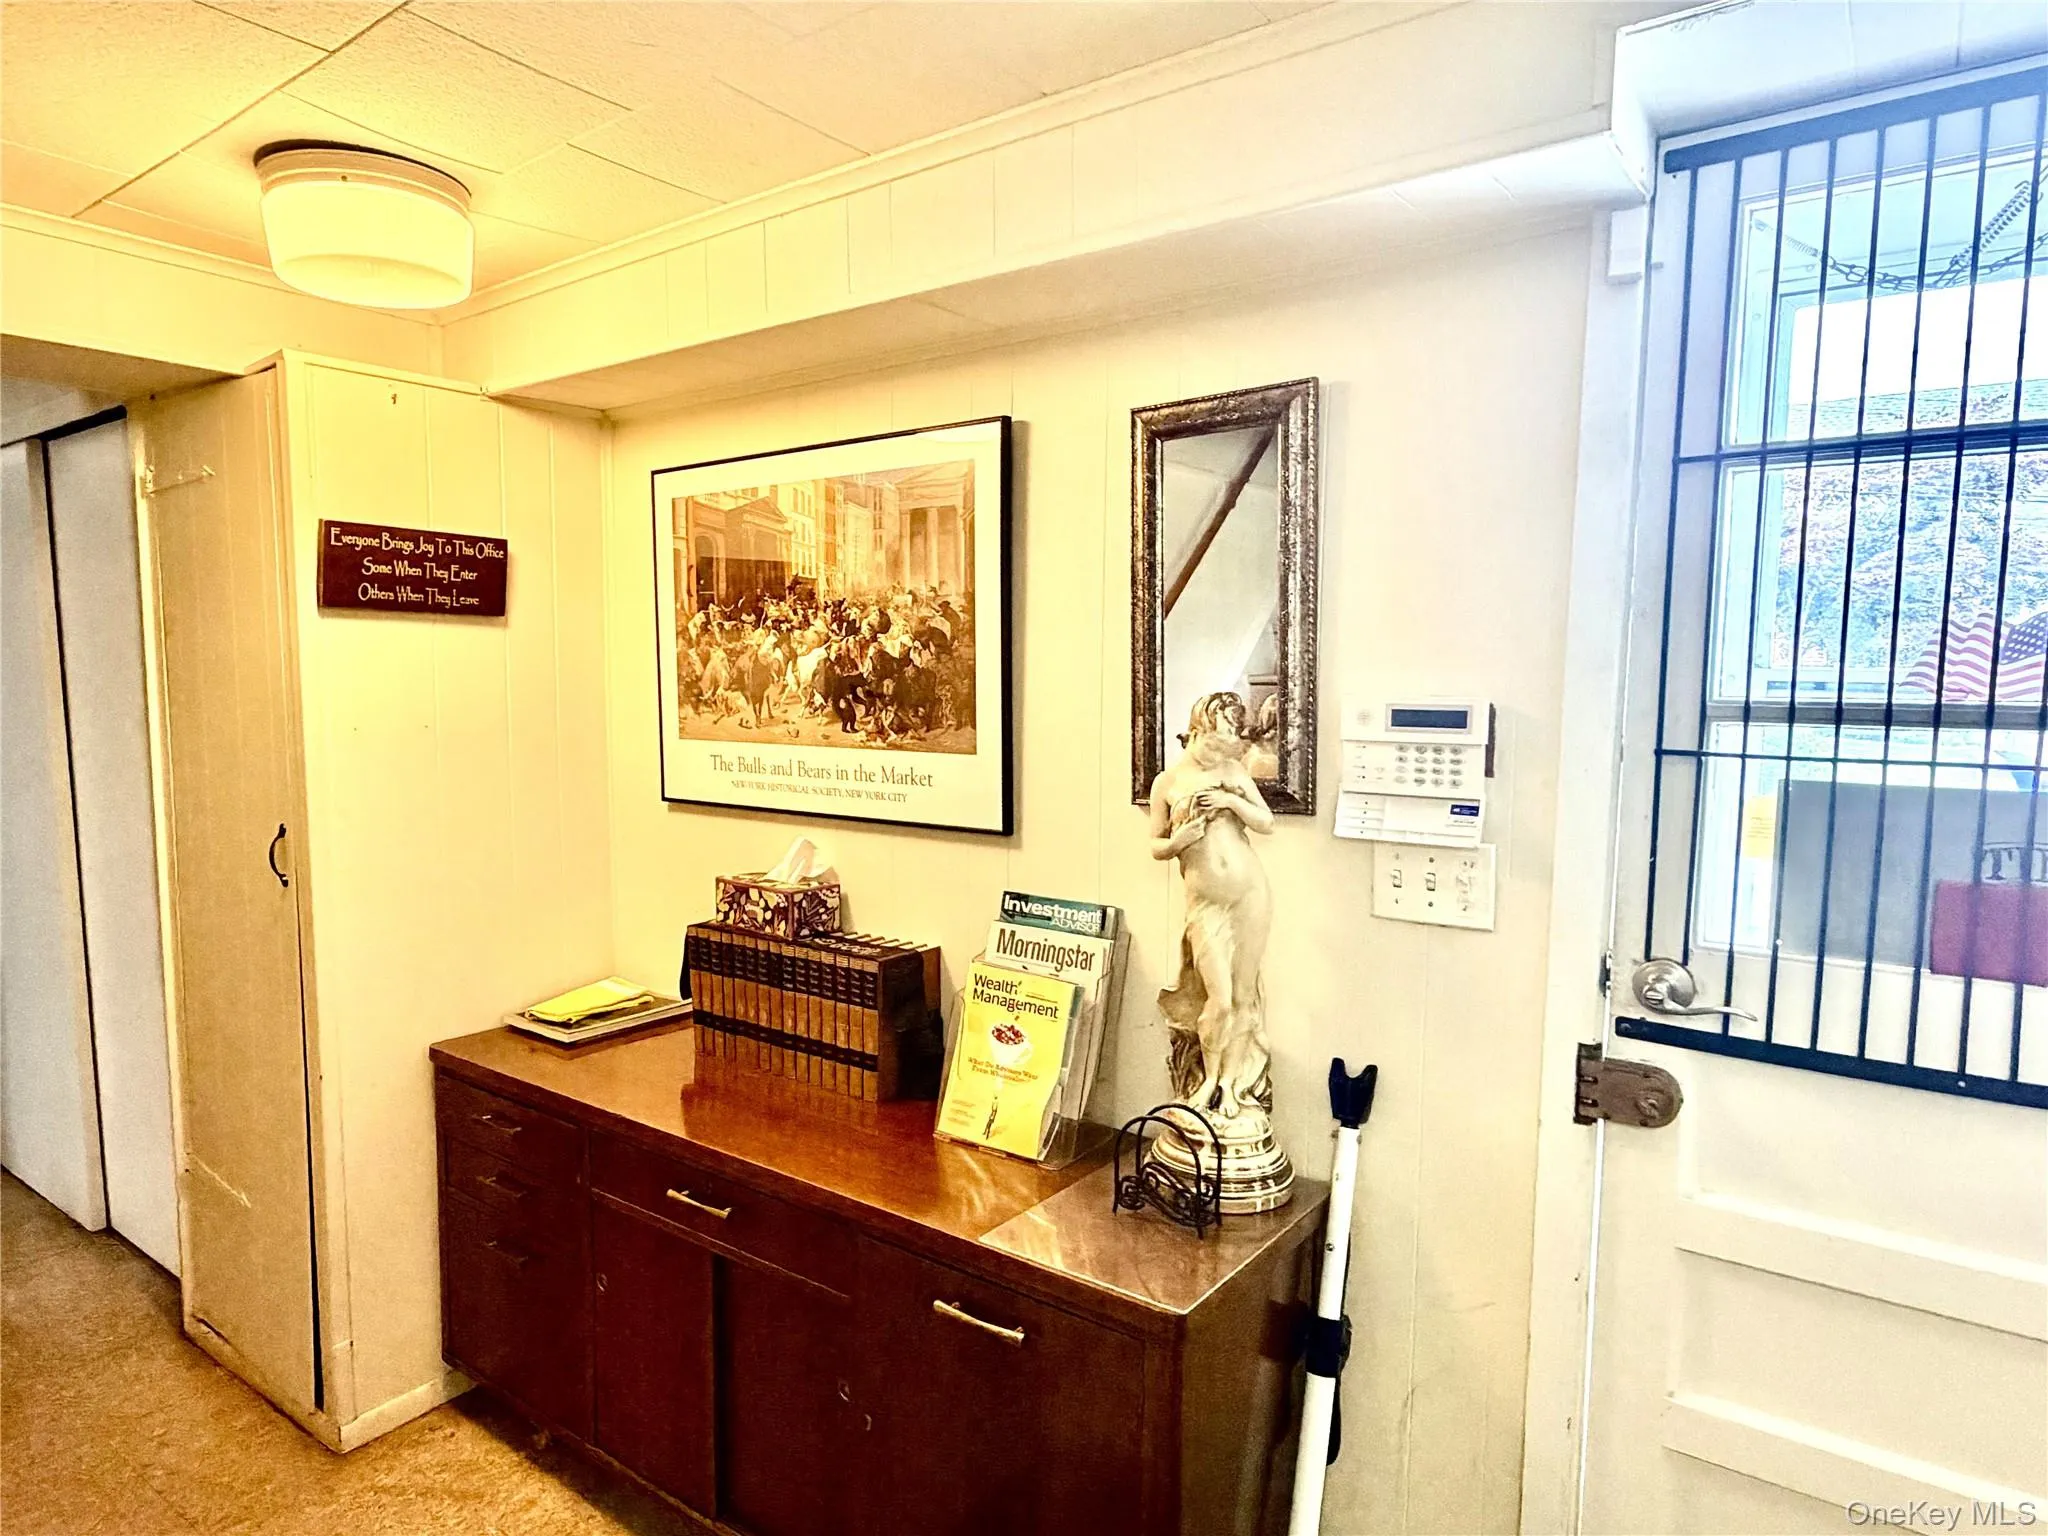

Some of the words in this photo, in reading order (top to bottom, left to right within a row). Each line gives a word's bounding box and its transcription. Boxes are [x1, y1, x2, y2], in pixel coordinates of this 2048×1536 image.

[330, 526, 380, 551] Everyone
[381, 532, 414, 555] Brings
[415, 536, 434, 557] Joy
[435, 538, 452, 555] To
[452, 539, 474, 557] This
[475, 541, 505, 559] Office
[361, 556, 392, 576] Some
[393, 559, 422, 578] When
[424, 561, 449, 583] They
[450, 564, 478, 582] Enter
[358, 582, 395, 601] Others
[396, 585, 424, 603] When
[425, 587, 451, 609] They
[452, 588, 480, 607] Leave
[710, 754, 734, 773] The
[737, 756, 767, 776] Bulls
[770, 759, 793, 777] and
[797, 760, 832, 781] Bears
[836, 764, 849, 782] in
[853, 764, 876, 784] the
[881, 765, 933, 788] Market
[767, 783, 809, 795] HISTORICAL
[845, 790, 863, 800] NEW
[865, 791, 887, 802] YORK
[887, 793, 908, 803] CITY
[1003, 894, 1103, 924] Investment
[1050, 918, 1101, 933] ADVISOR
[996, 928, 1096, 973] Morningstar
[974, 973, 1018, 996] Wealth
[972, 987, 1060, 1020] Management
